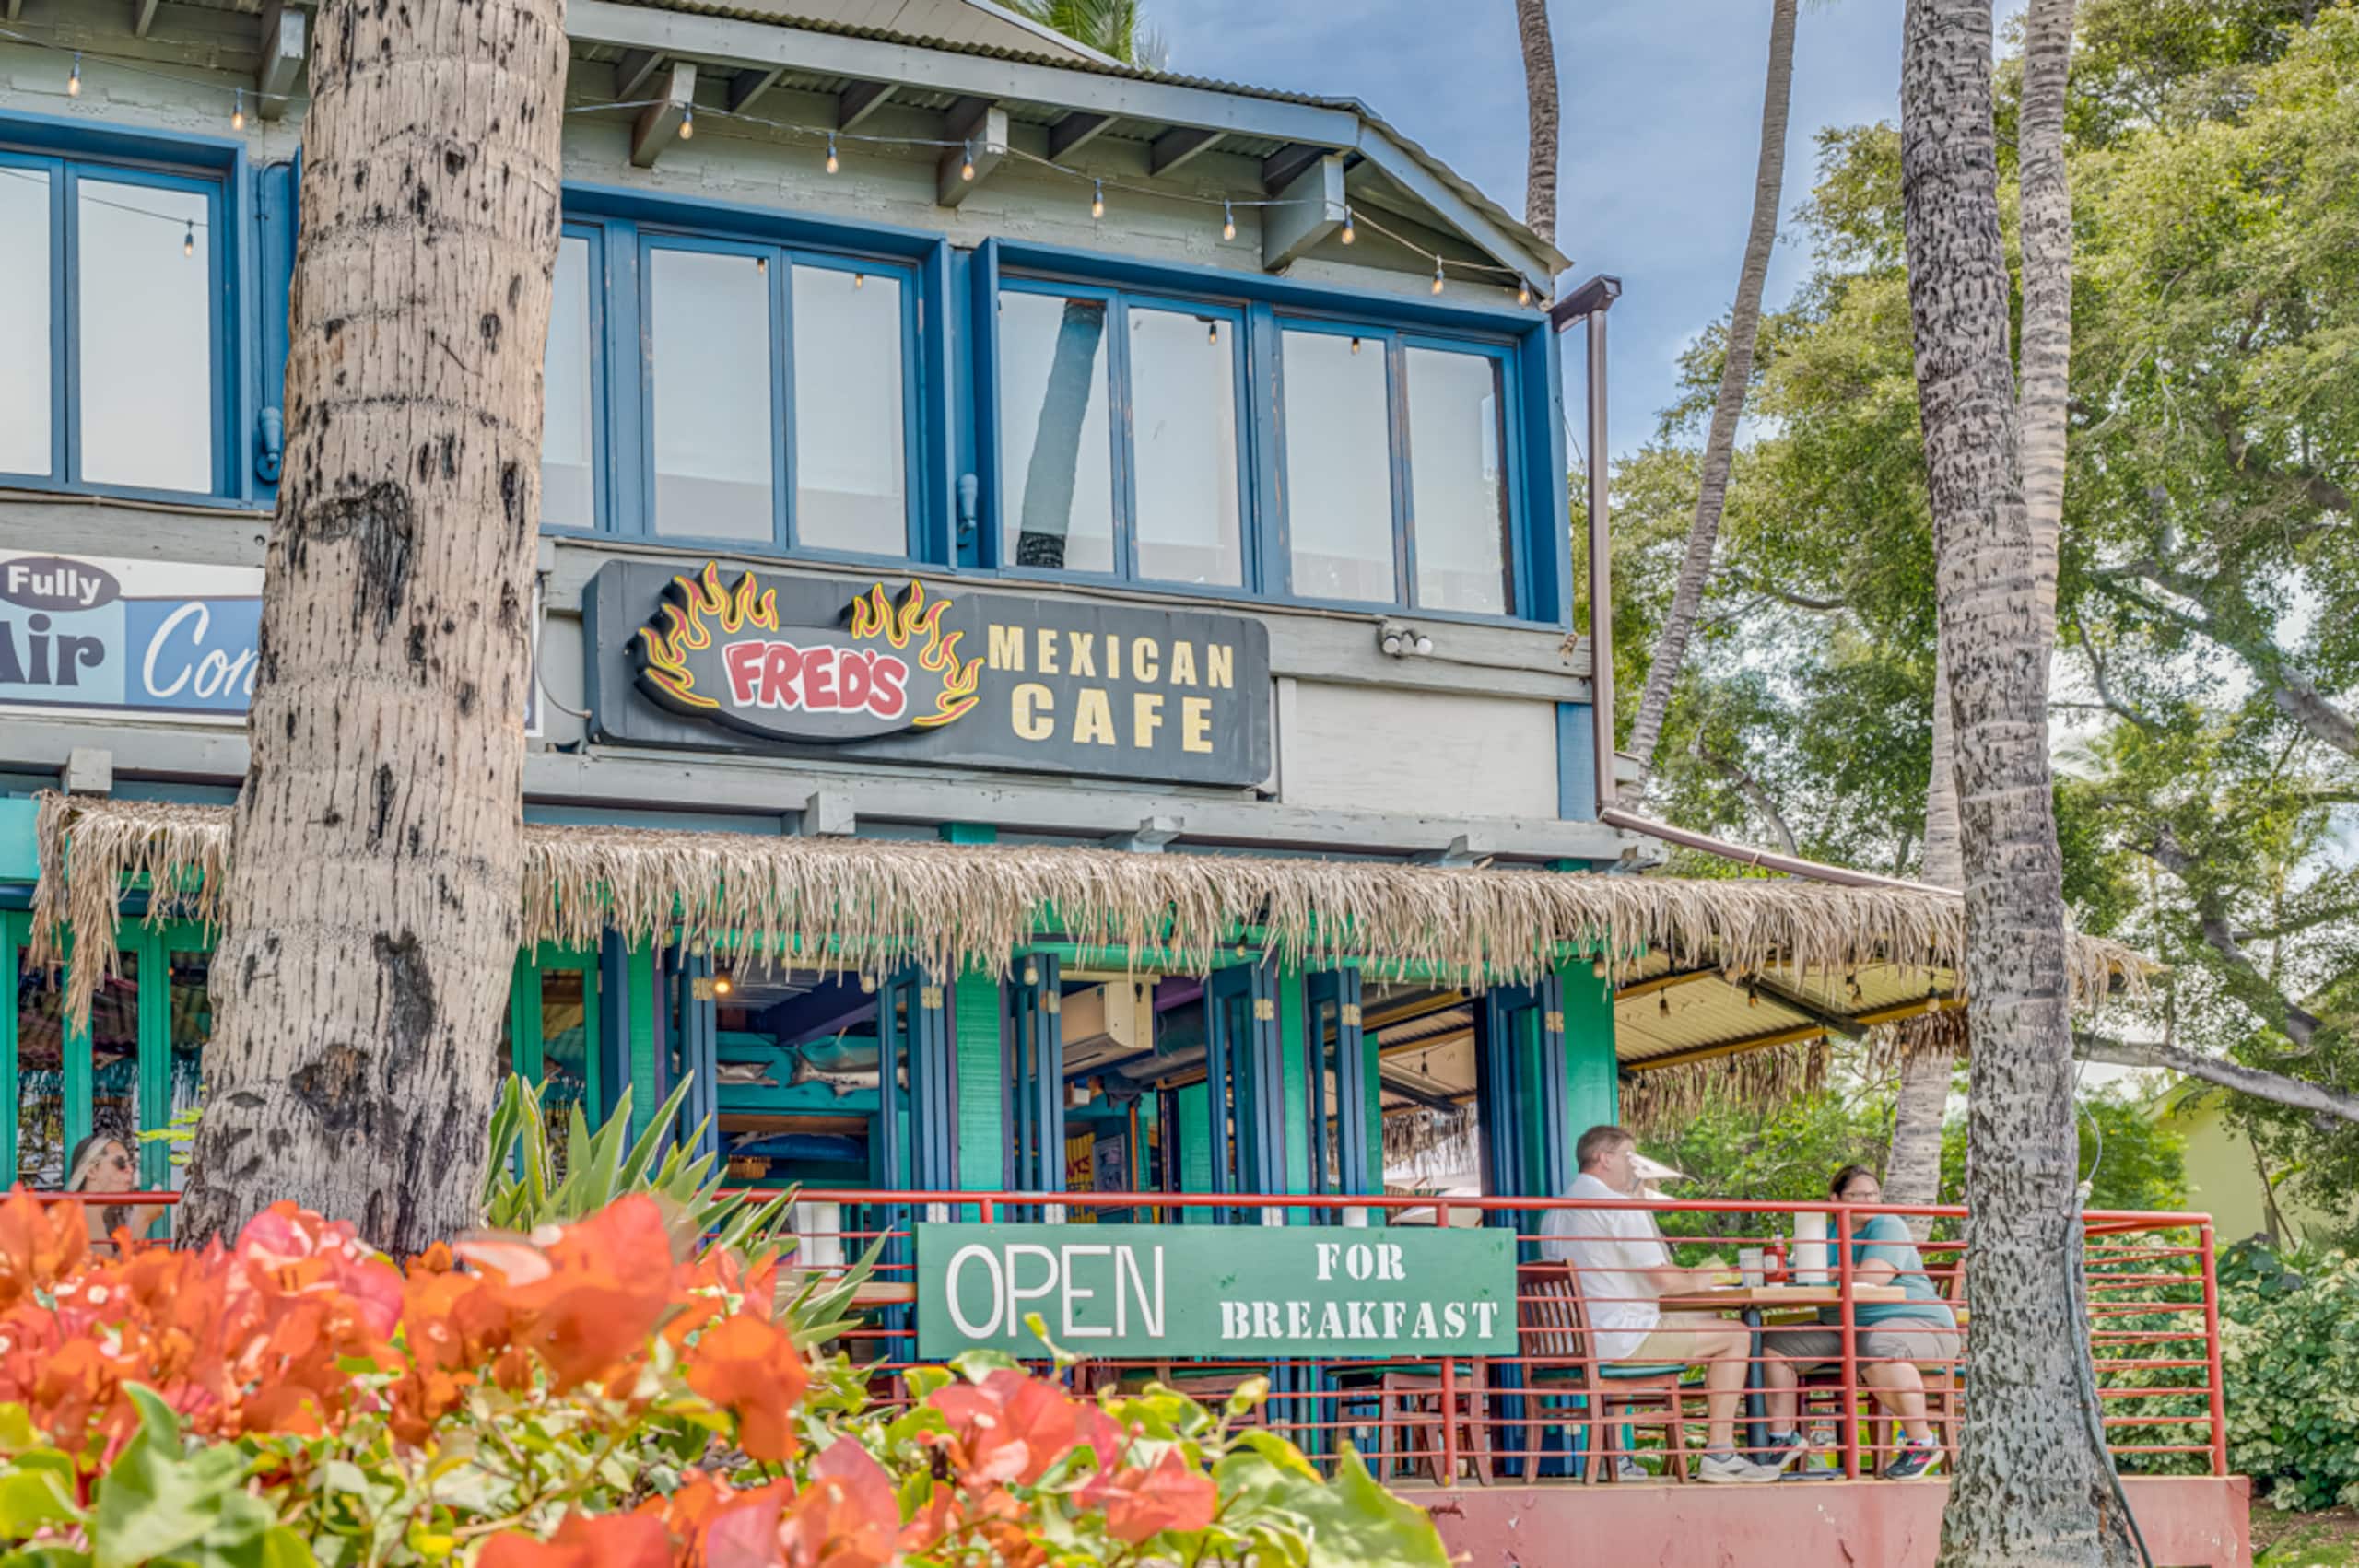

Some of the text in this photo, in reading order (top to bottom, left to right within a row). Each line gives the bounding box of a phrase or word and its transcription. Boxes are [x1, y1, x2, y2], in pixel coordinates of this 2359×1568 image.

[8, 565, 101, 605] Fully
[722, 639, 910, 720] FRED'S
[988, 624, 1234, 688] MEXICAN
[1011, 683, 1213, 753] CAFE
[946, 1244, 1165, 1339] OPEN
[1315, 1243, 1406, 1281] FOR
[1220, 1301, 1498, 1339] BREAKFAST
